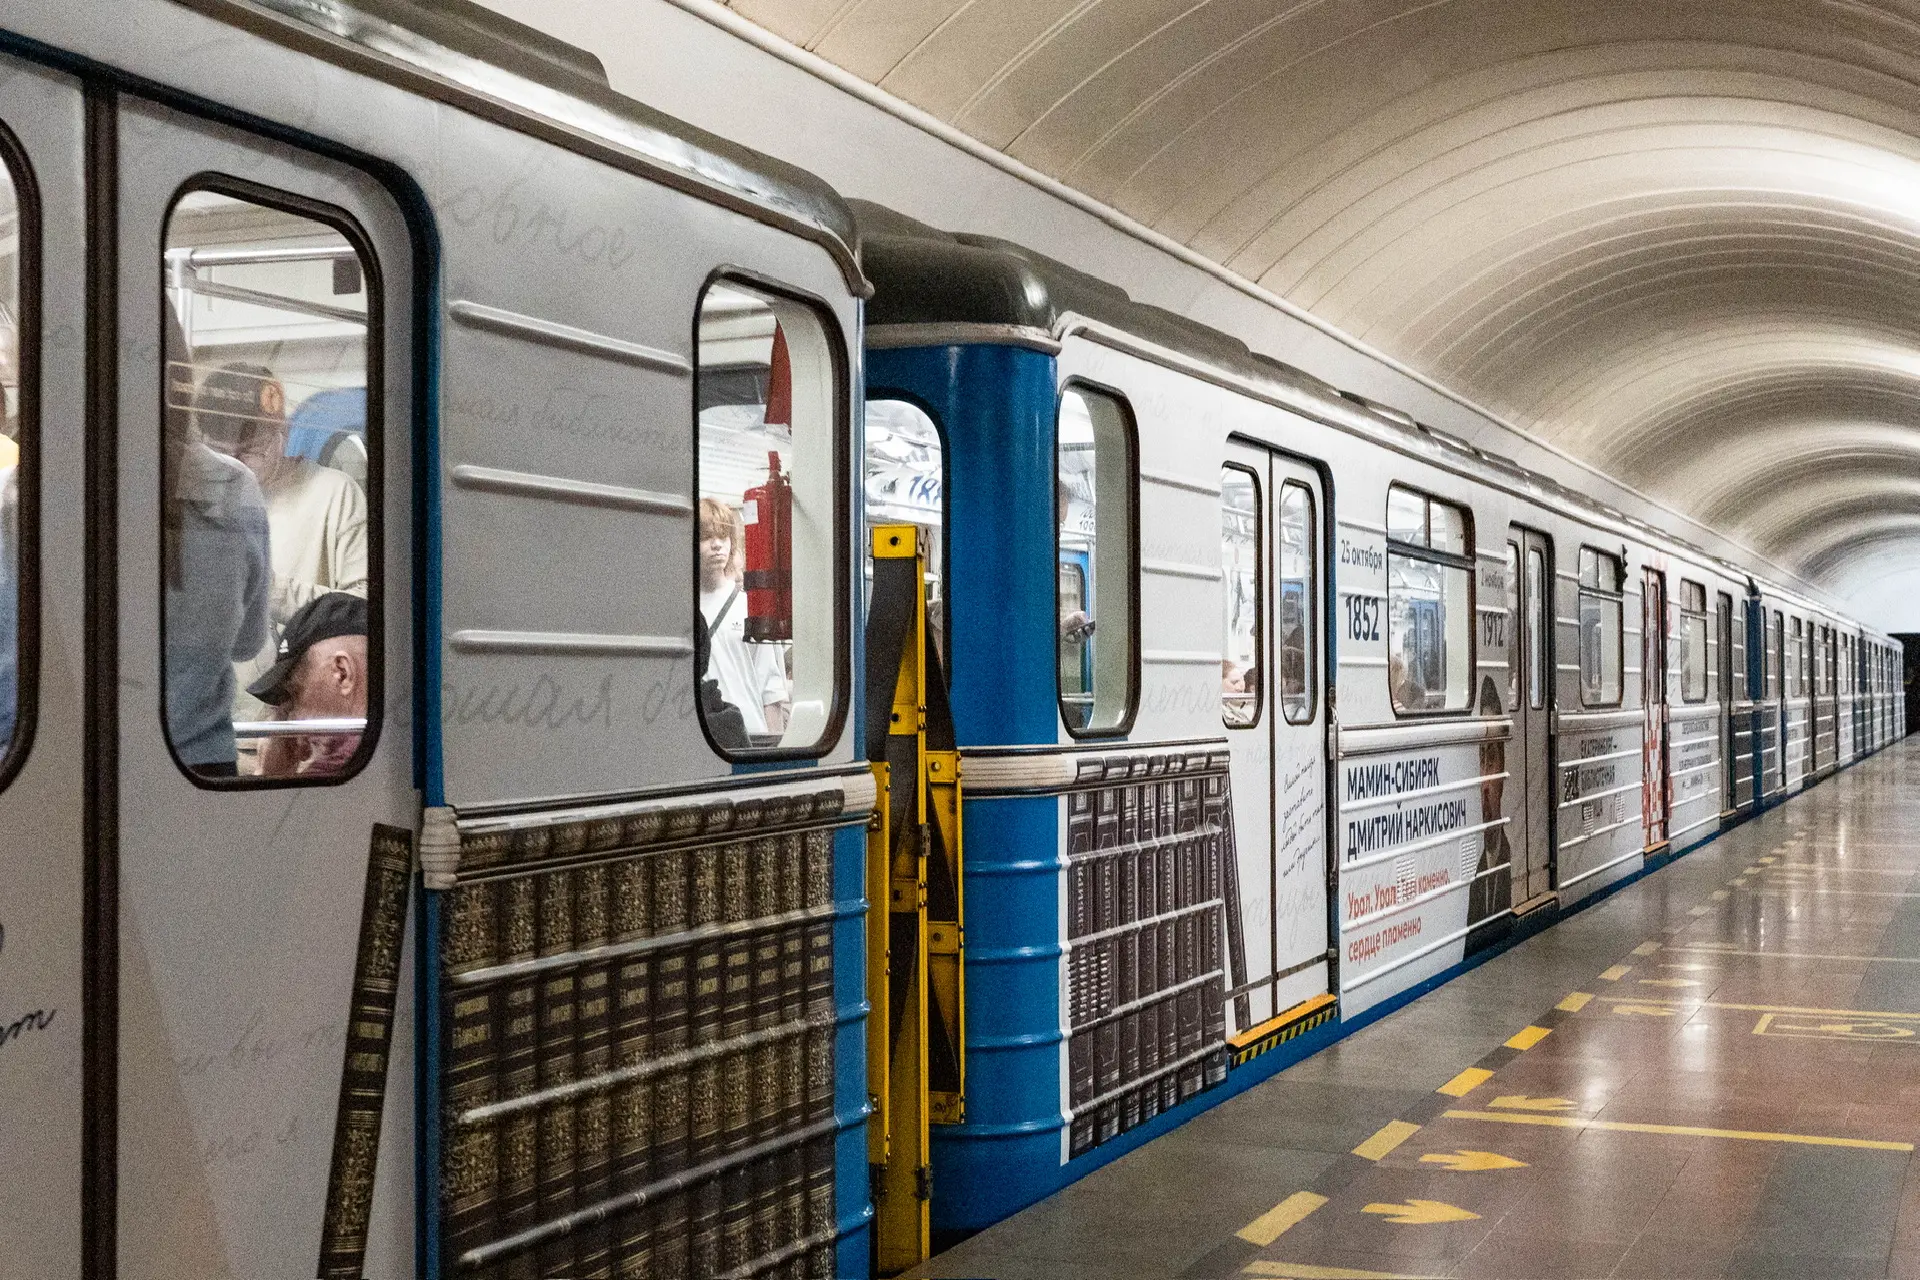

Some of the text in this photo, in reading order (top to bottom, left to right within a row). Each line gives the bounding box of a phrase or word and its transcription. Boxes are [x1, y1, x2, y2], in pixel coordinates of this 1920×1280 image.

[1341, 539, 1383, 575] 25 октября
[1345, 593, 1380, 641] 1852
[1482, 610, 1504, 648] 1912
[1347, 757, 1440, 801] МАМИН-СИБИРЯК
[1347, 801, 1404, 863] ДМИТРИЙ
[1405, 798, 1467, 842] НАРКИСОВИЧ
[1348, 916, 1422, 967] сердце пламенно
